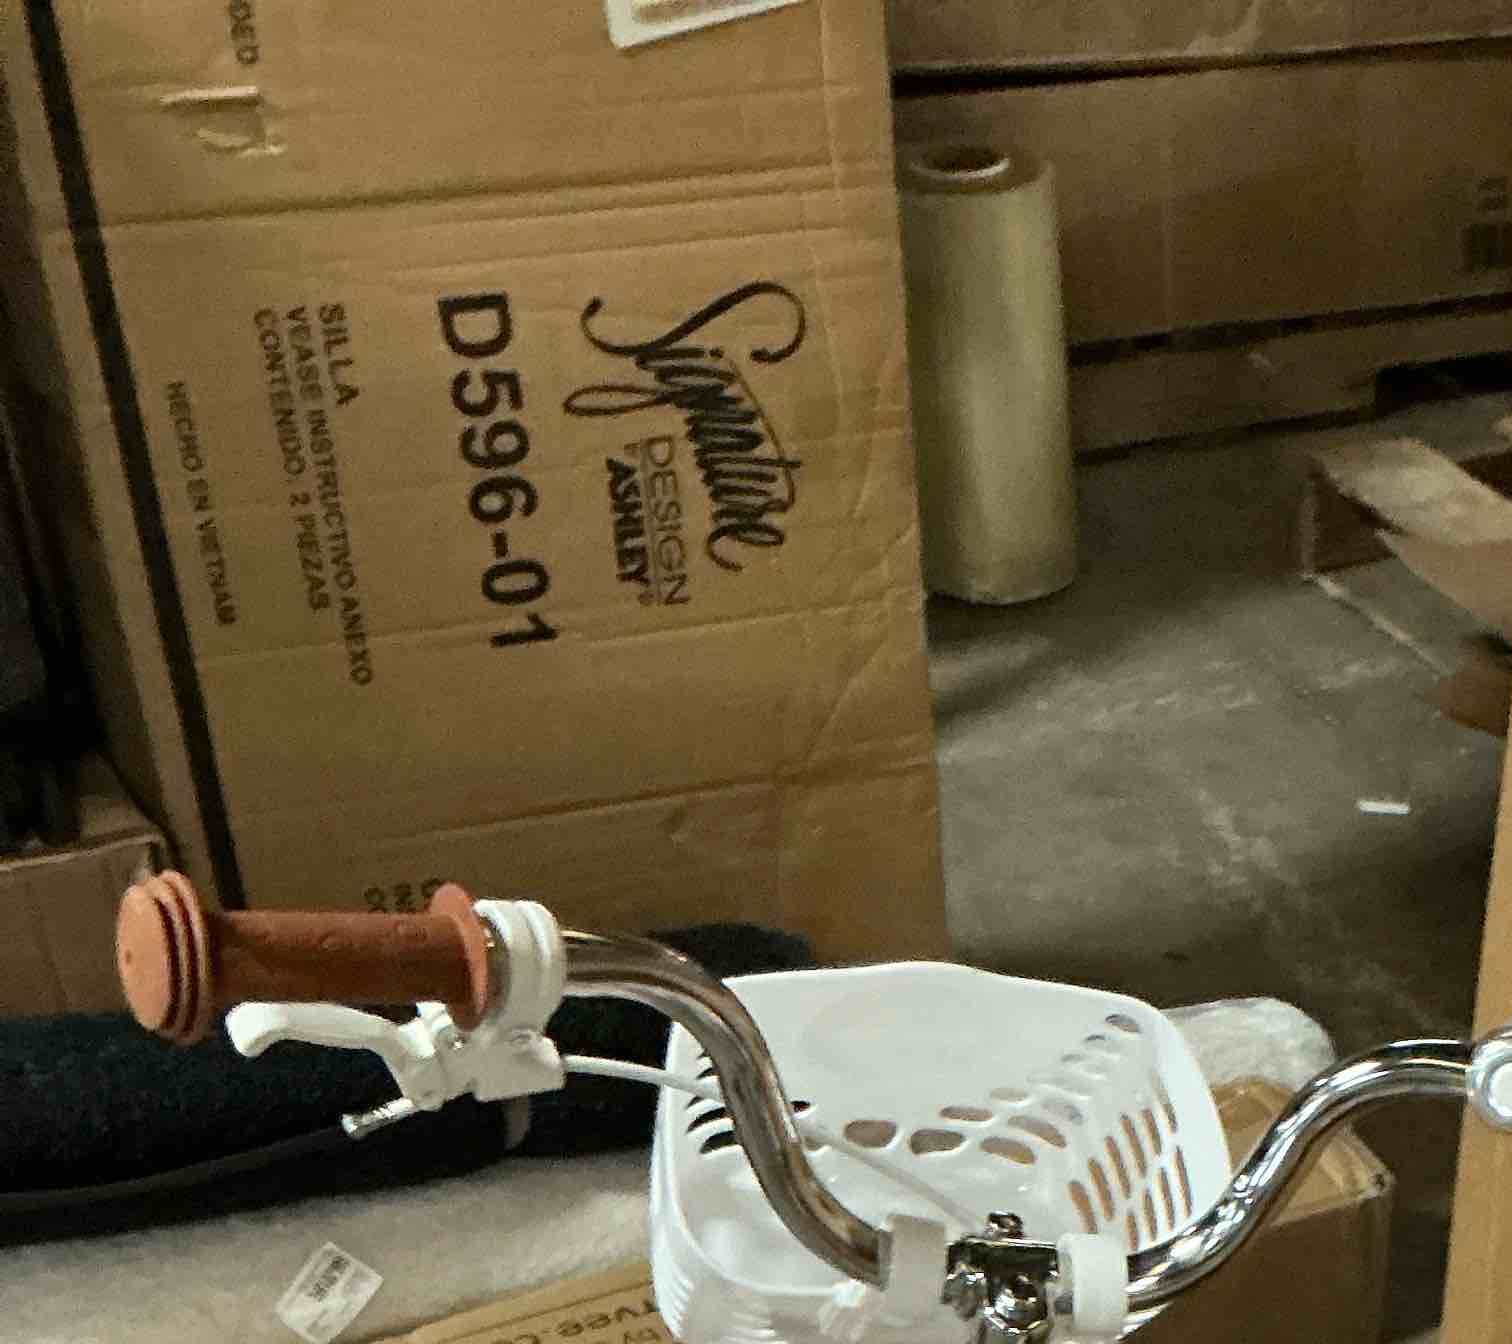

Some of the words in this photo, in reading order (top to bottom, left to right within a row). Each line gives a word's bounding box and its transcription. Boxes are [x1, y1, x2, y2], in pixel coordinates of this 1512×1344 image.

[318, 303, 360, 408] SILLA
[562, 281, 805, 574] Signature
[288, 491, 313, 508] 2
[437, 289, 558, 649] D596-01
[606, 457, 651, 586] ASHLEY
[648, 433, 691, 606] DESIGN
[294, 513, 332, 614] PIEZAS
[304, 408, 358, 591] INSTRUCTIVO
[339, 596, 373, 688] ANEXO
